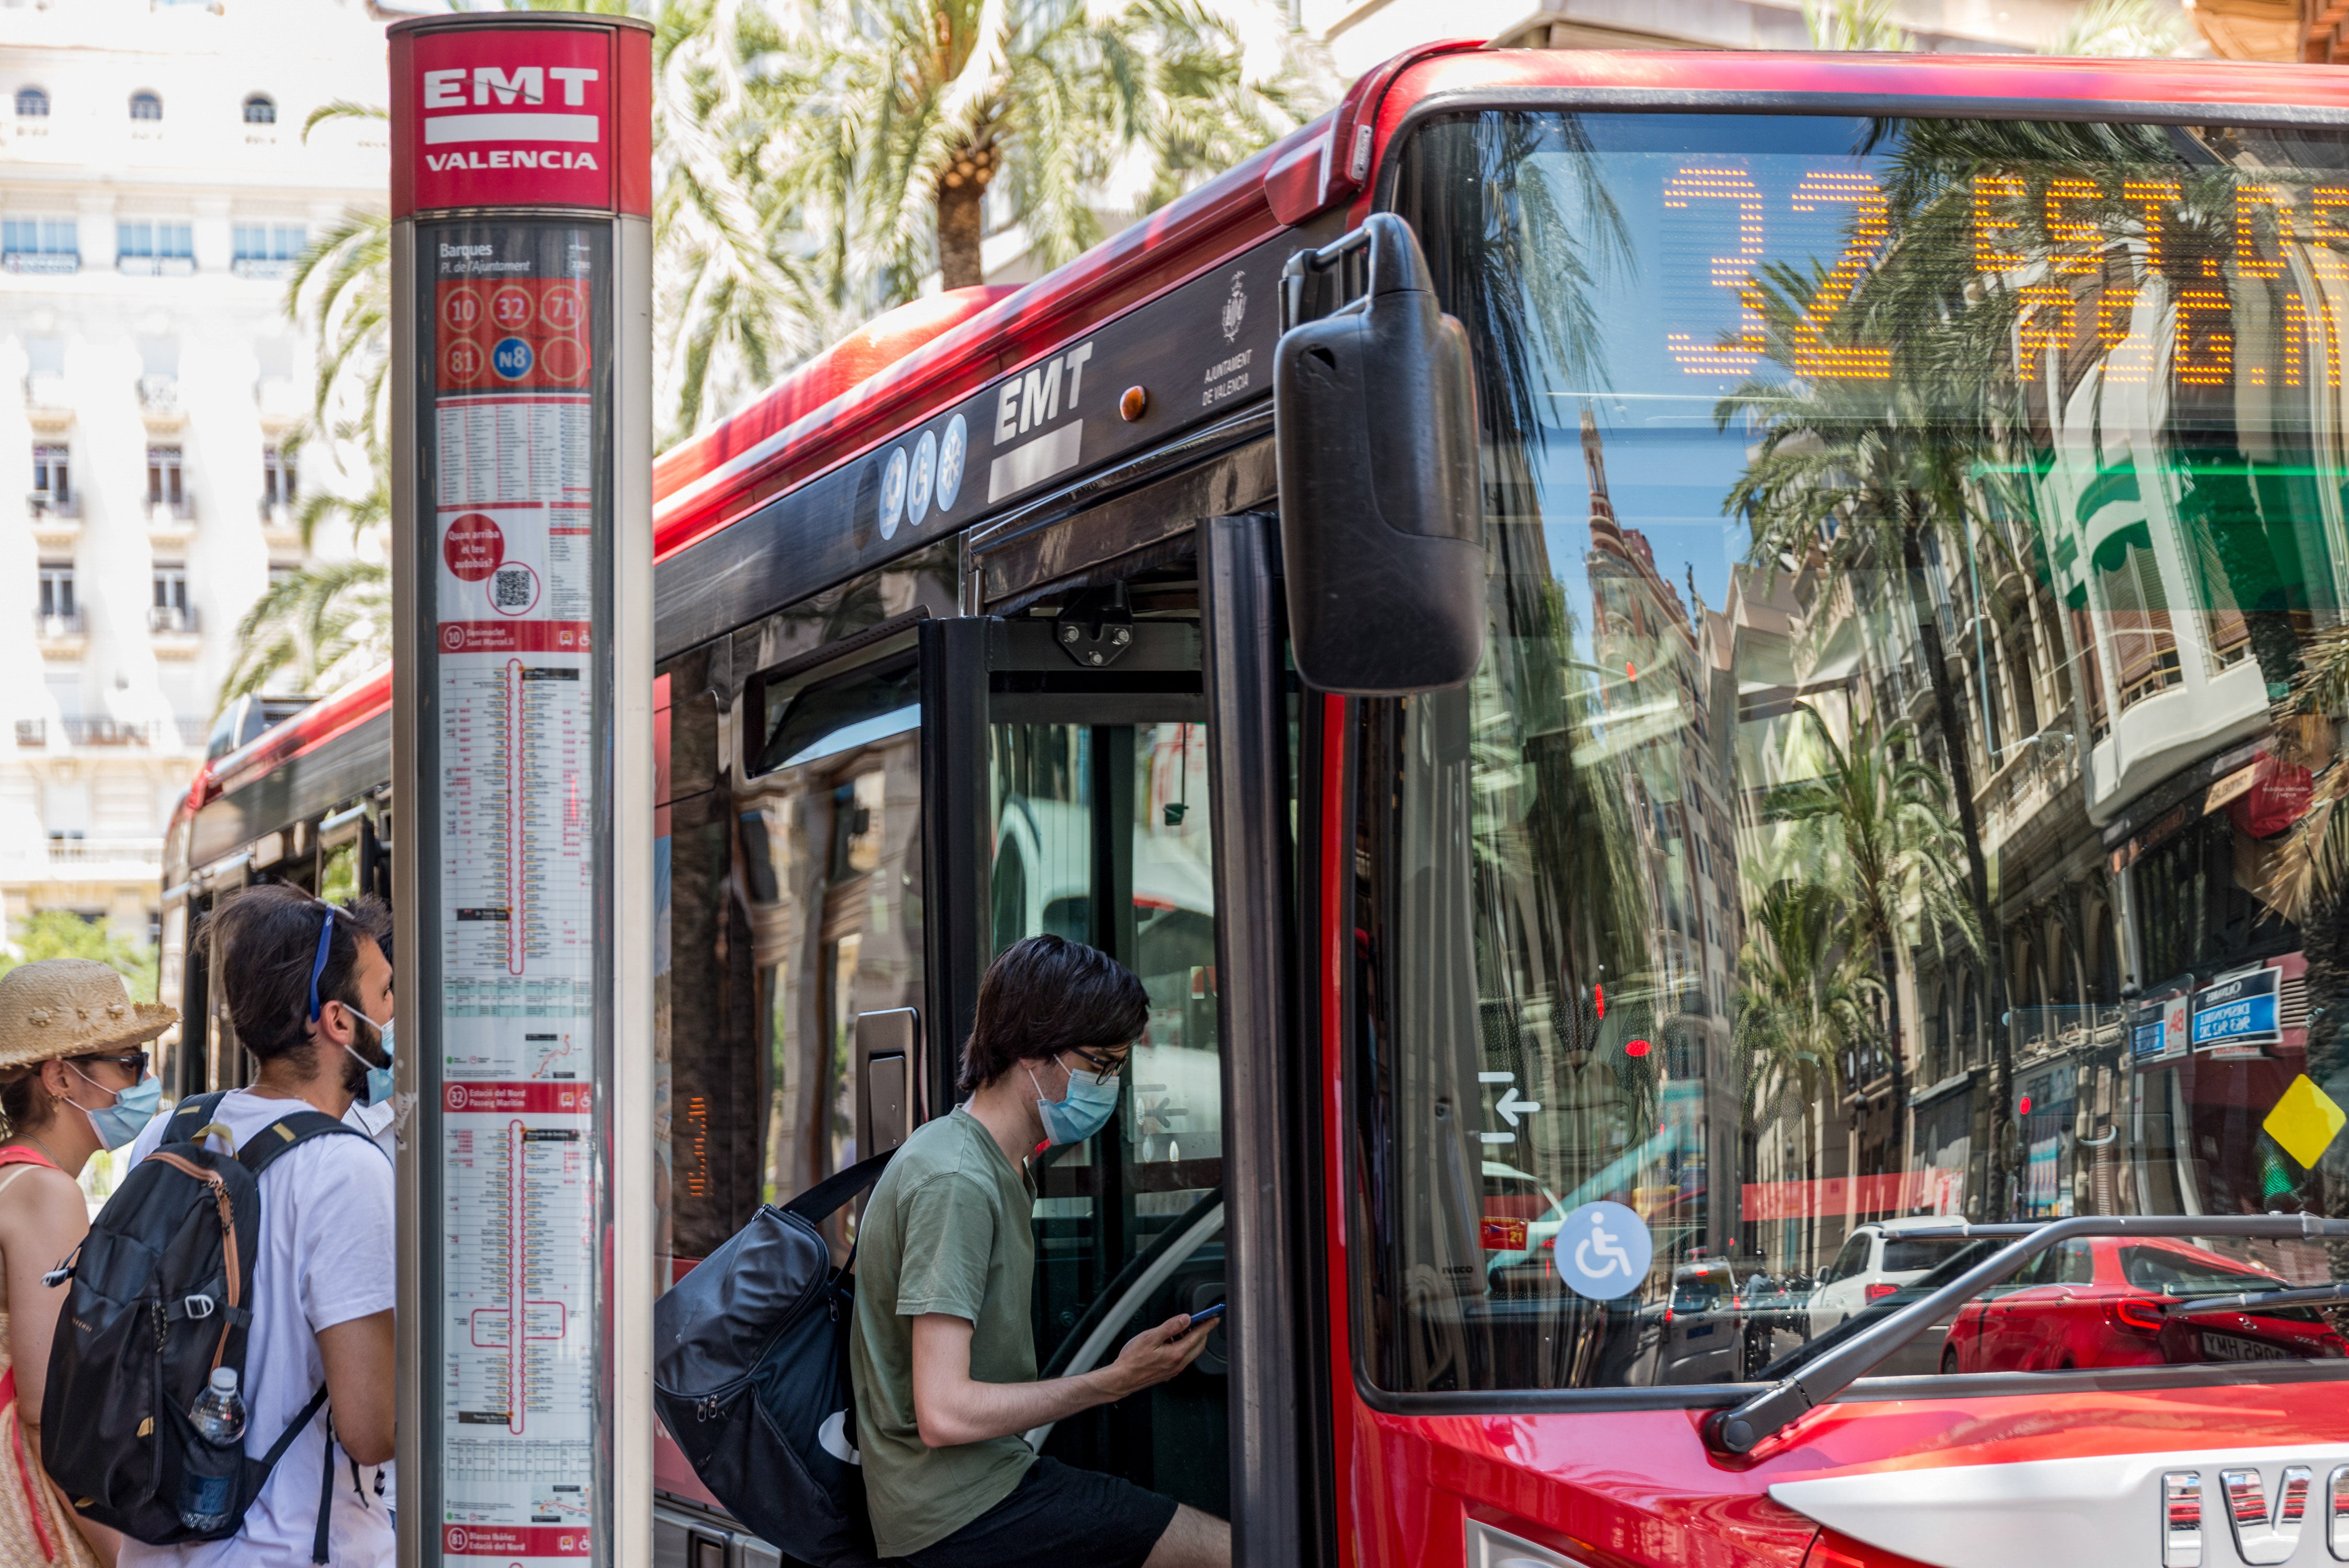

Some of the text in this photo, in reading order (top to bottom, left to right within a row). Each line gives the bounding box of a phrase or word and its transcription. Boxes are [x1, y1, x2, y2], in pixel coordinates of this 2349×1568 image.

[424, 66, 598, 109] EMT
[425, 151, 599, 171] VALENCIA
[440, 243, 493, 260] Barques
[441, 260, 531, 274] Pl. de l'Ajuntament
[1664, 168, 1891, 378] 32
[452, 296, 577, 321] 10 32 71
[451, 346, 526, 373] 81 N8
[1204, 349, 1252, 384] AJUNTAMENT
[994, 341, 1093, 446] EMT
[1202, 388, 1213, 406] DE
[448, 529, 499, 540] Quan arriba
[461, 545, 469, 553] el
[454, 558, 493, 569] autobús?
[448, 631, 459, 643] 10
[450, 1090, 463, 1103] 32
[1509, 1231, 1523, 1243] 21
[1442, 1265, 1473, 1274] IVECO
[451, 1534, 463, 1546] 81
